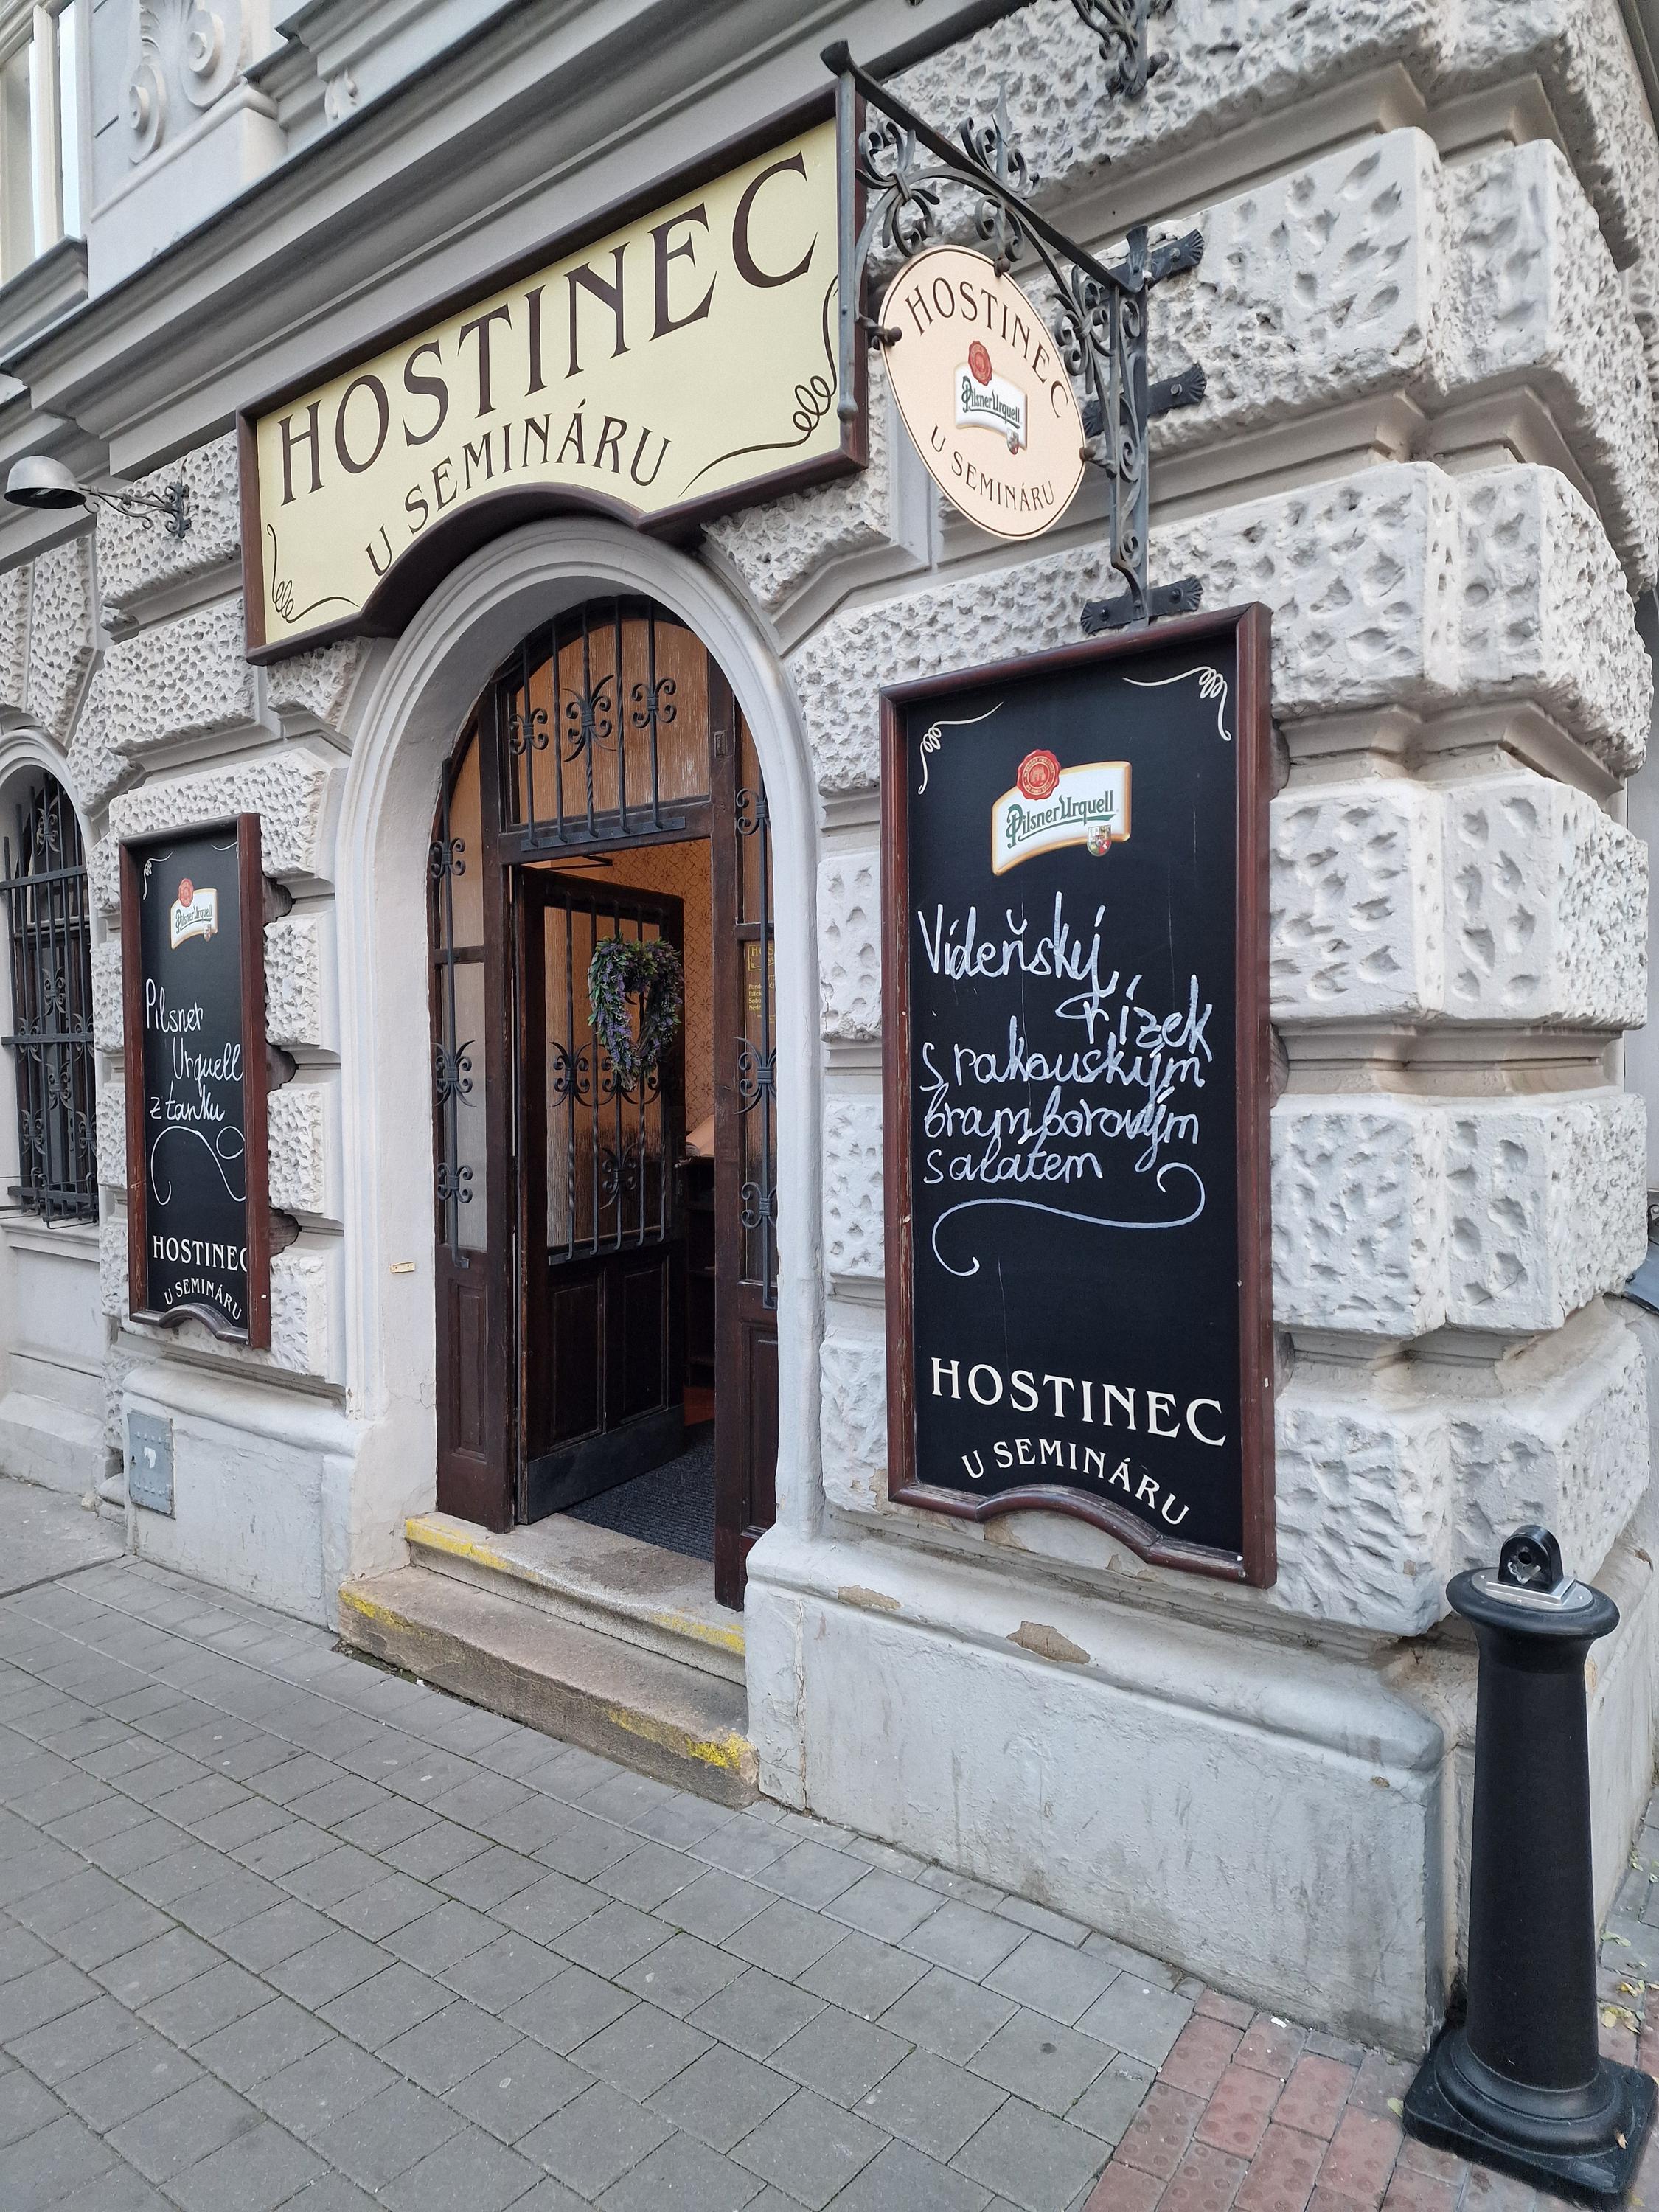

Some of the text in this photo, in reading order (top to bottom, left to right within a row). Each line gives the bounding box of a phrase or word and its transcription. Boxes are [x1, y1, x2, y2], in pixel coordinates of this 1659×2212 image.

[277, 151, 818, 507] HOSTINEC
[905, 276, 1069, 418] HOSTINEC
[961, 375, 1020, 424] Pilsner Urquell
[364, 398, 672, 577] U SEMINÁRU
[931, 425, 1055, 512] U SEMINÁRU
[1006, 790, 1114, 849] Pilsner Urquell
[175, 903, 212, 934] Pilsner Urquell
[917, 891, 1119, 998] Vídeňský
[146, 978, 204, 1033] Pilsner
[165, 1080, 226, 1121] tanku
[172, 1036, 244, 1097] Urquell
[954, 1015, 1206, 1106] rakouským
[924, 1082, 1199, 1172] bramborovým
[164, 1277, 243, 1321] U SEMINÁRU
[931, 1357, 1228, 1447] HOSTINEC
[961, 1438, 1190, 1526] U SEMINÁRU
